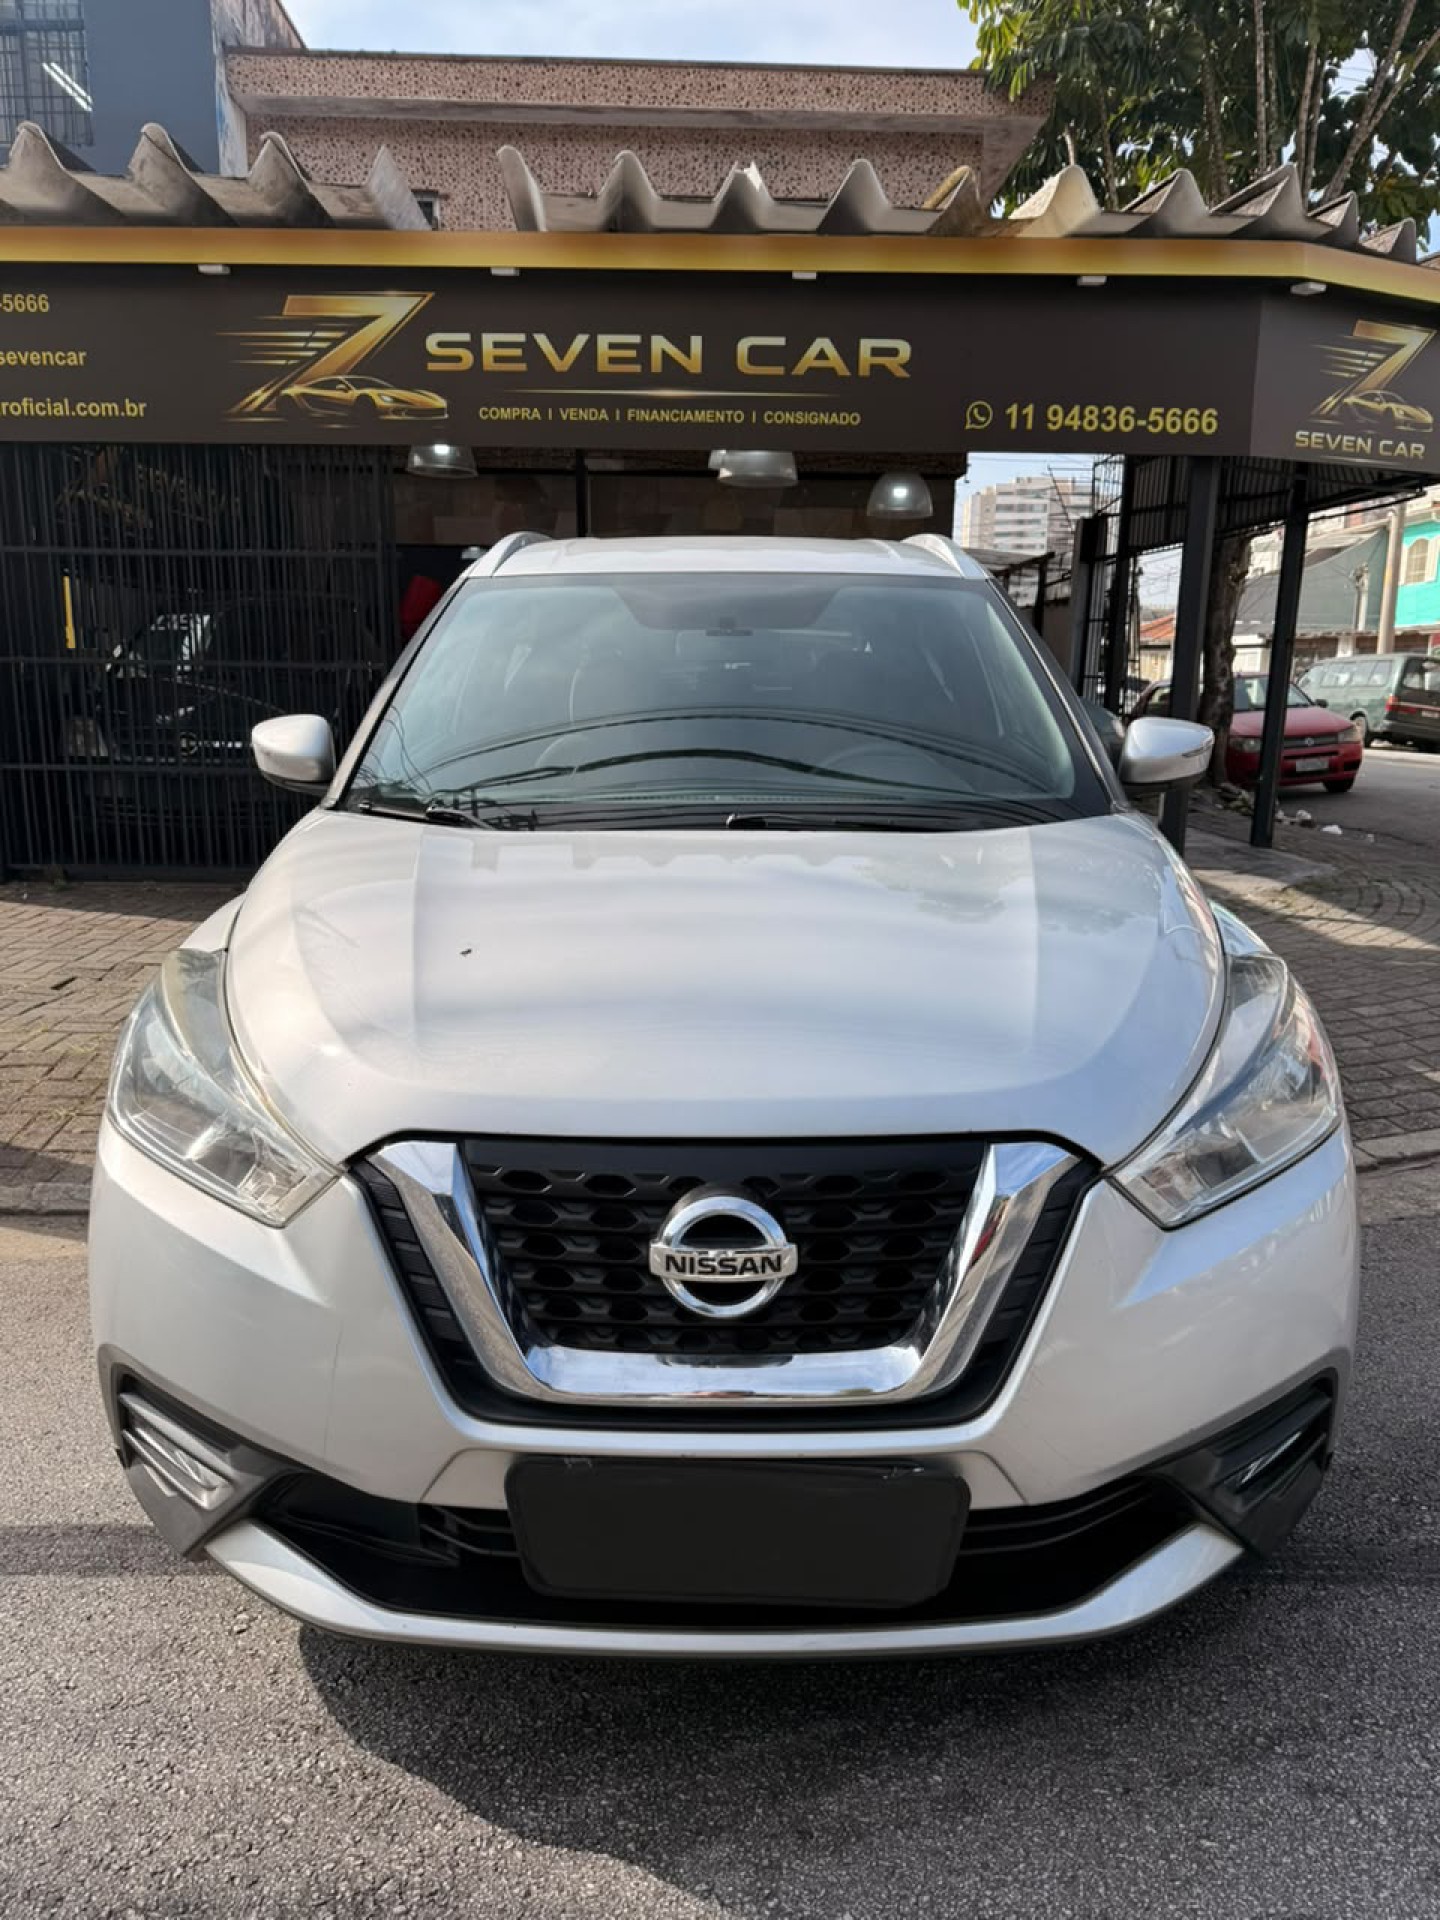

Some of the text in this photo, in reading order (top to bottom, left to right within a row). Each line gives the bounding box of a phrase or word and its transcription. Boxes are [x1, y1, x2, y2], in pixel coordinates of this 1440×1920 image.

[425, 333, 912, 378] SEVEN CAR
[0, 397, 146, 418] roficial.com.br
[478, 407, 541, 421] COMPRA
[559, 408, 609, 422] VENDA
[627, 409, 745, 424] FINANCIAMENTO
[763, 410, 861, 426] CONSIGNADO
[1005, 403, 1219, 436] 11 94836-5666
[1294, 430, 1426, 460] SEVEN CAR
[664, 1253, 784, 1274] NISSAN
